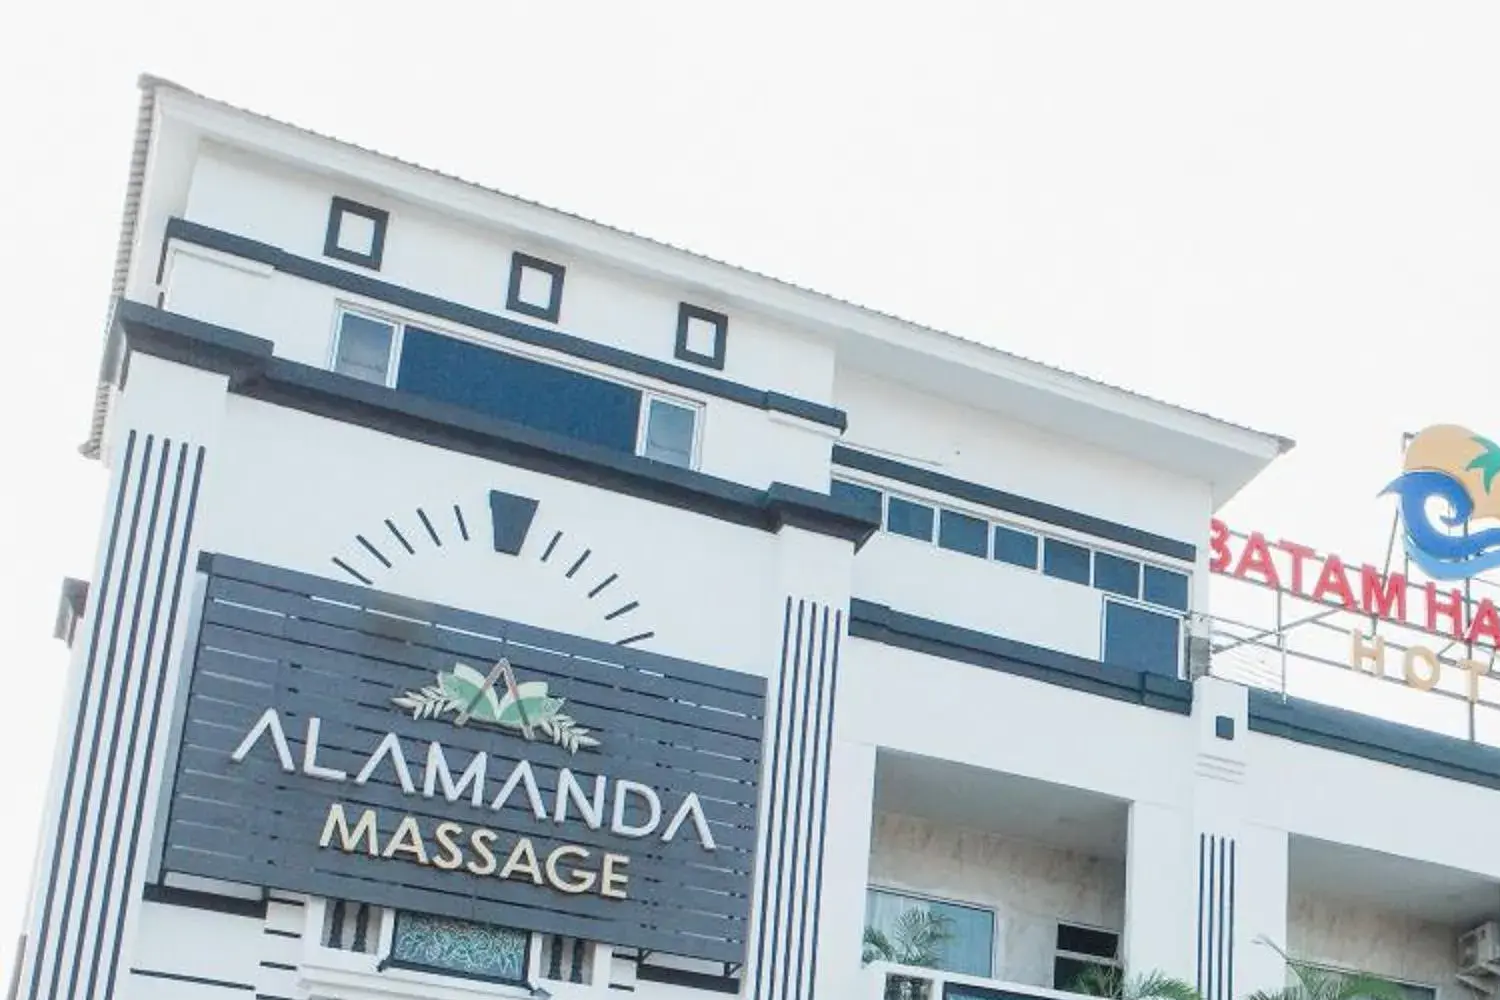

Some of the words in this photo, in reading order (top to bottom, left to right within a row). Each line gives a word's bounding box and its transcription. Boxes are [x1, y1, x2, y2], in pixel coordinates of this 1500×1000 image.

[1210, 517, 1407, 624] BATAM
[230, 706, 717, 851] ALAMANDA
[319, 803, 631, 900] MASSAGE
